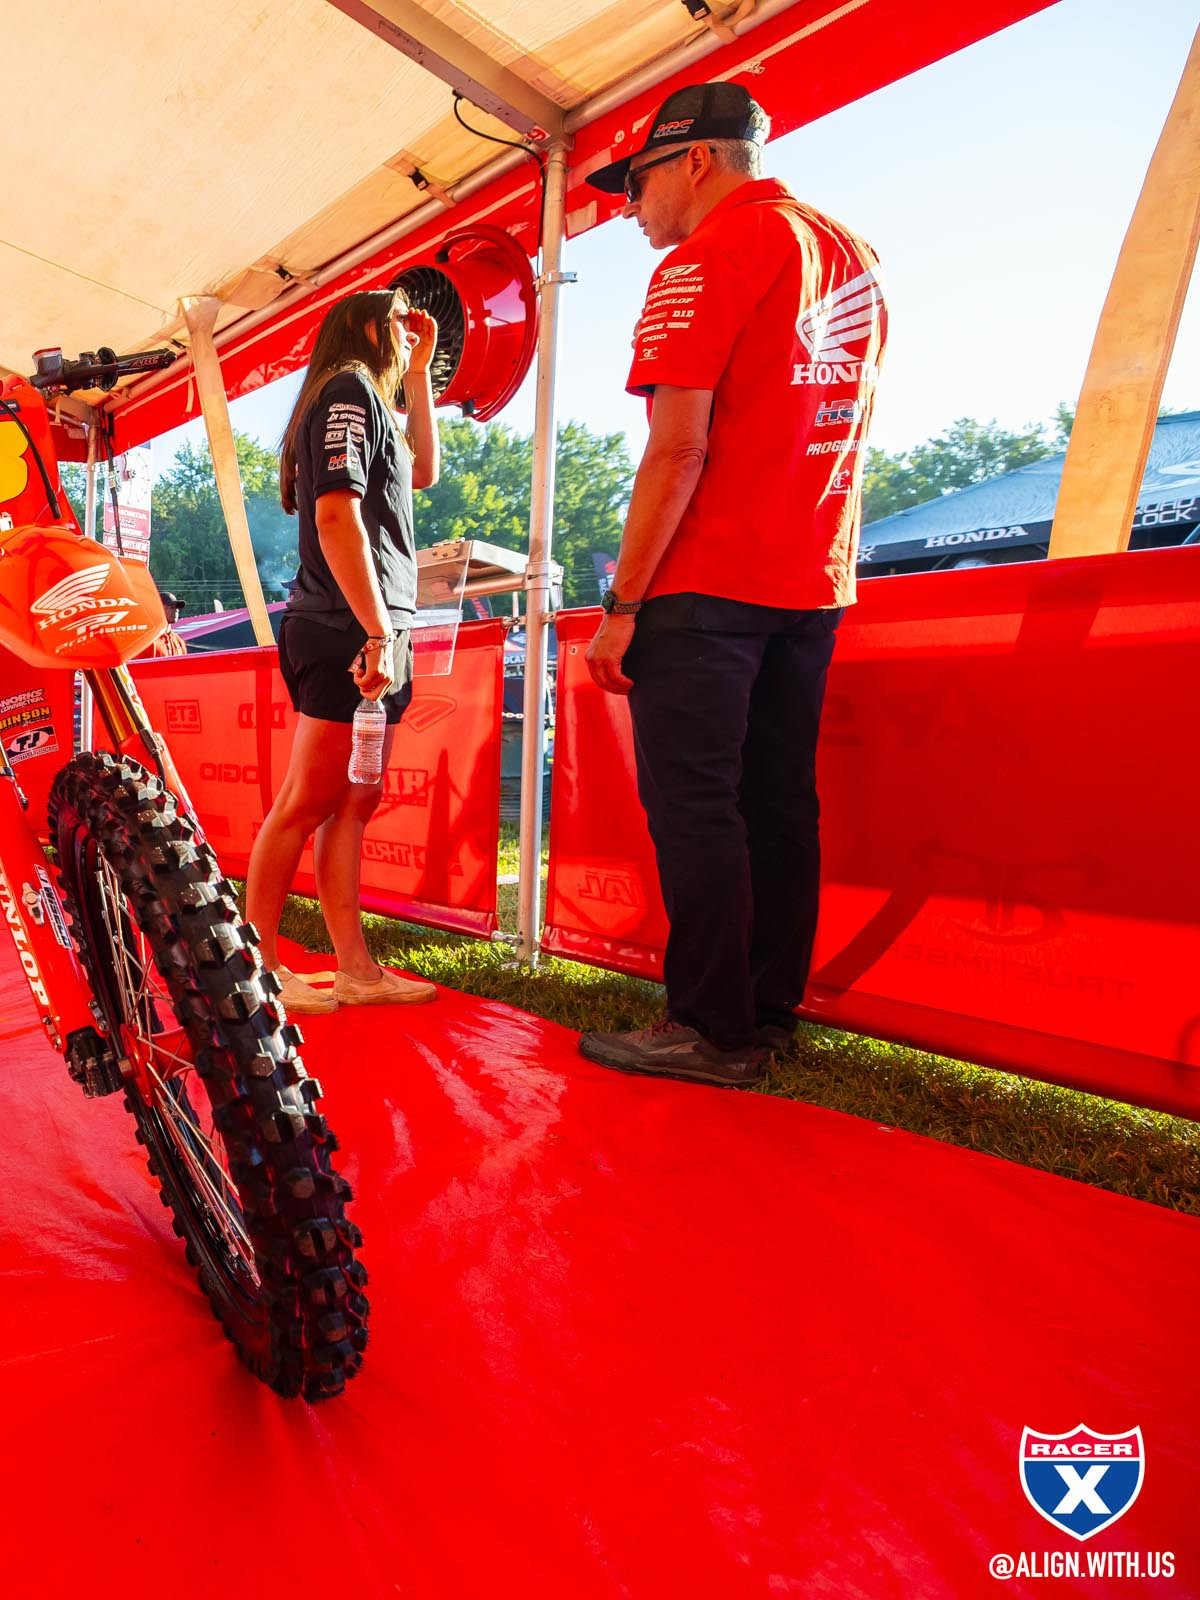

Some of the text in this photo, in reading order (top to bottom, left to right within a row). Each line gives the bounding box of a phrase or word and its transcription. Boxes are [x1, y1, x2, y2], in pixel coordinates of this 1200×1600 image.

[654, 119, 694, 136] HRC
[924, 525, 1029, 548] HONDA
[37, 597, 140, 631] HONDA
[0, 695, 44, 713] CONNECTION
